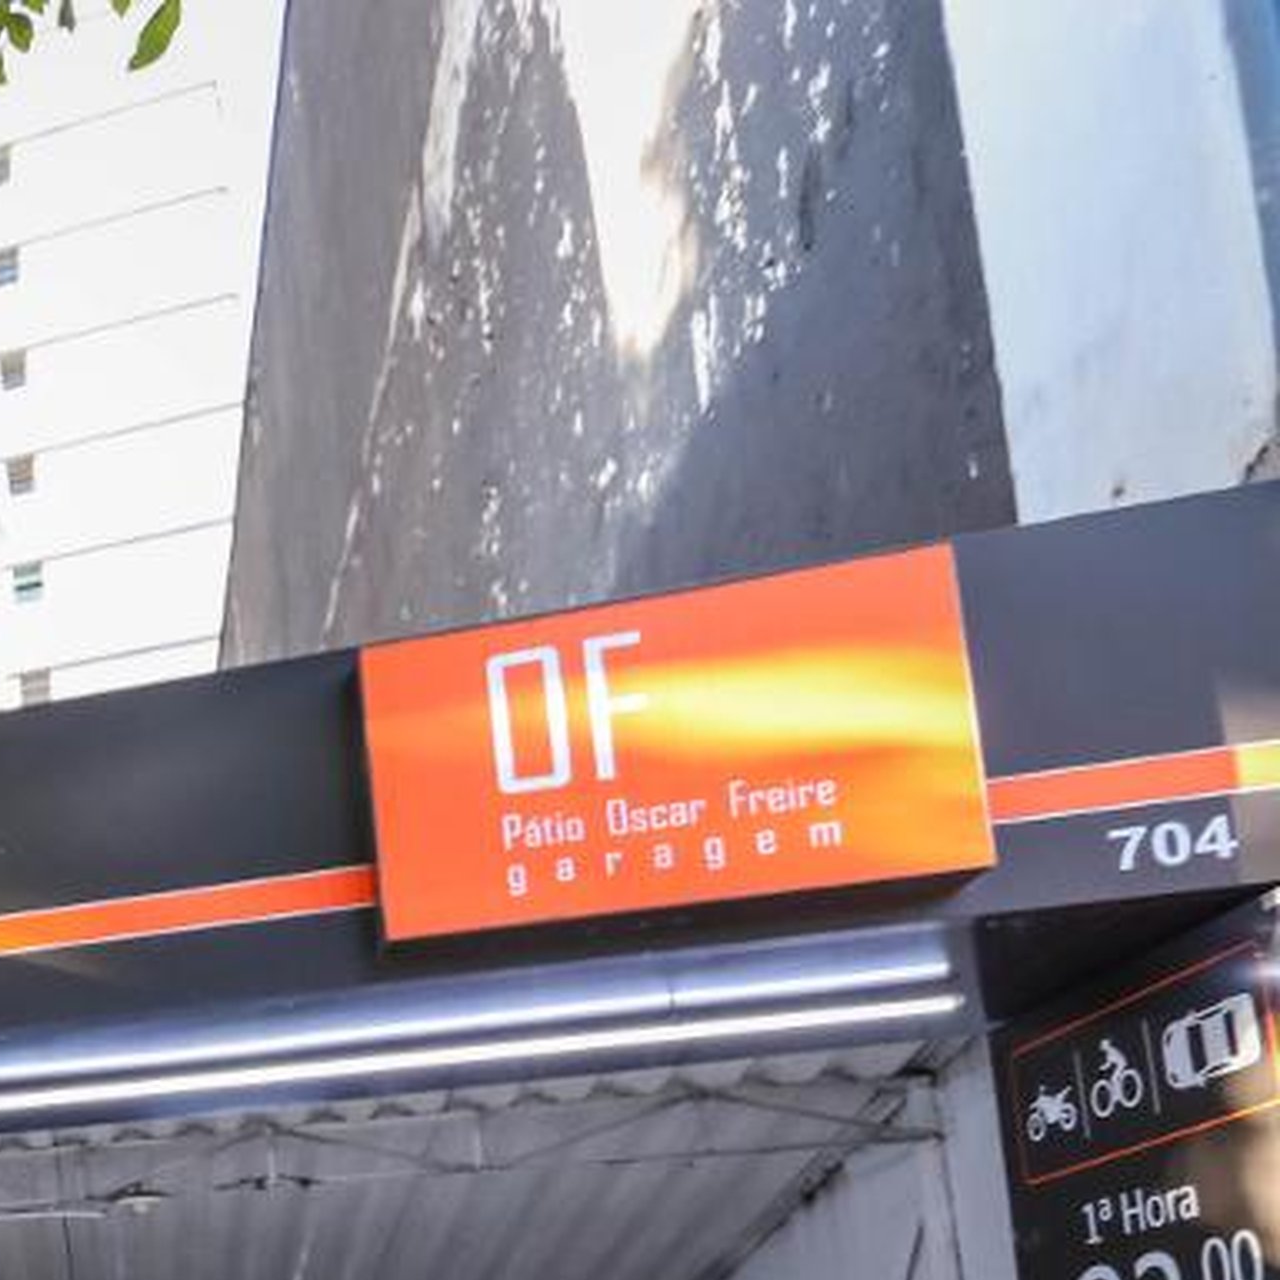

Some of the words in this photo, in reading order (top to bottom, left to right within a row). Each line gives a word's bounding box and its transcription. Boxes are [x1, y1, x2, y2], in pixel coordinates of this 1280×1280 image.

[485, 629, 646, 794] OF
[502, 811, 586, 851] Pátio
[605, 797, 706, 846] Oscar
[728, 776, 838, 818] Freire
[1107, 812, 1240, 873] 704
[1120, 1184, 1200, 1235] Hora
